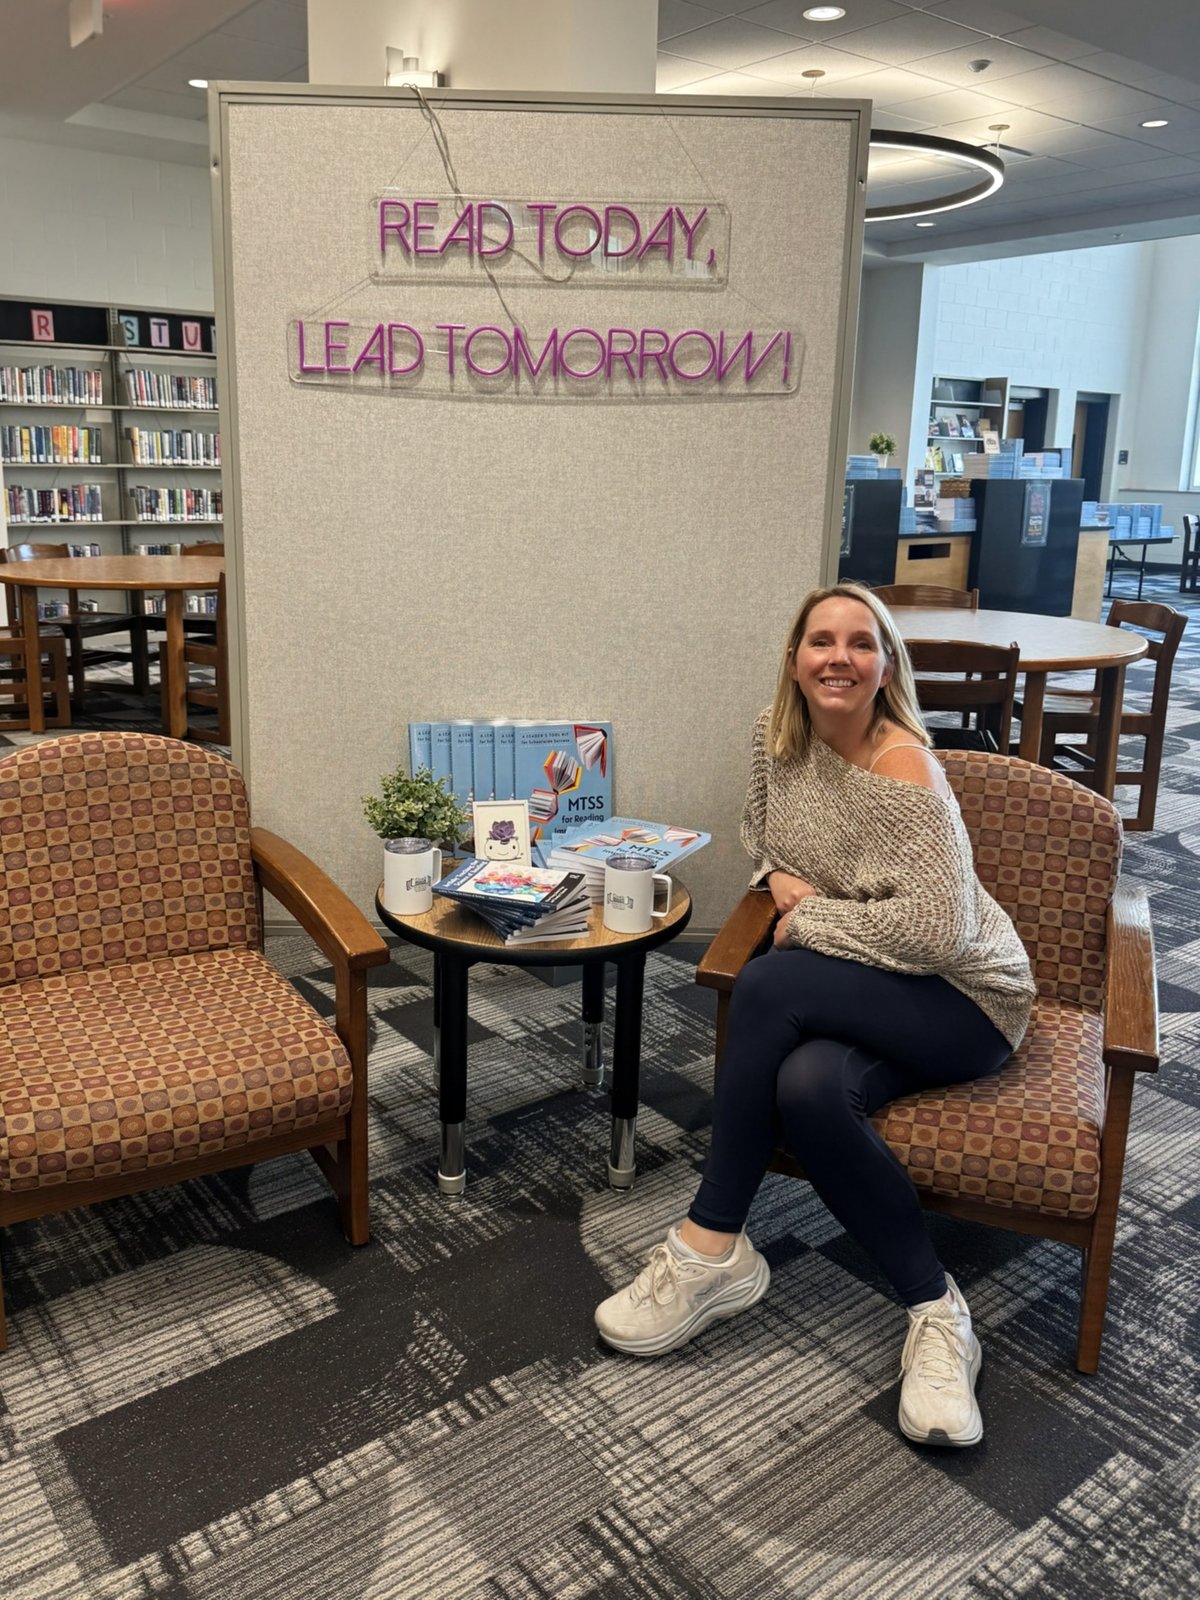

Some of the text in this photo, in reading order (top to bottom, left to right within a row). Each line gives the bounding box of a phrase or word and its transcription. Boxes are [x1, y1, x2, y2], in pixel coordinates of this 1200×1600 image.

[380, 200, 716, 265] READ TODAY,
[37, 314, 51, 336] R
[124, 320, 135, 341] S
[151, 321, 167, 343] T
[184, 325, 199, 346] U
[298, 319, 792, 384] LEAD TOMORROW!
[568, 795, 604, 811] MTSS
[562, 813, 605, 823] for Reading
[629, 844, 672, 857] MTSS
